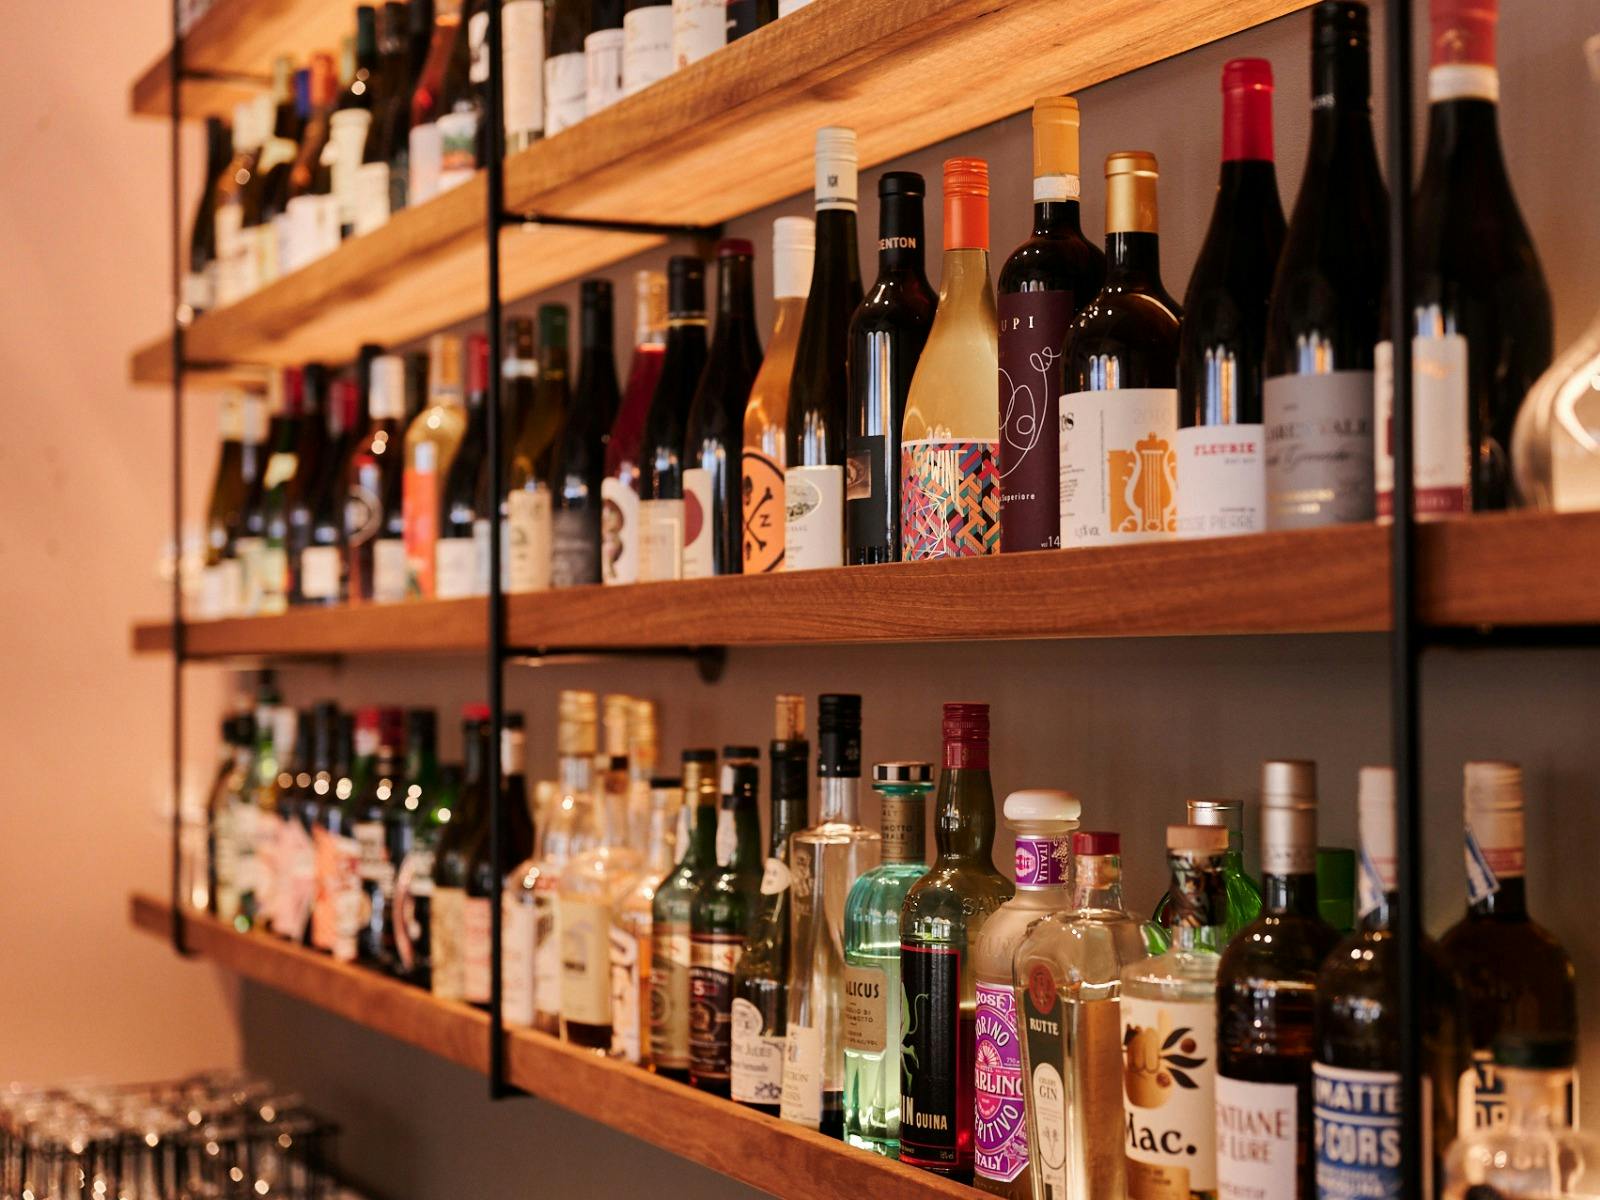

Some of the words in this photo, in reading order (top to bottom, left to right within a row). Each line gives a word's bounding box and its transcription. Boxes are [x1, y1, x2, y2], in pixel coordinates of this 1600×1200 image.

[1037, 844, 1048, 882] ITALIA
[1030, 1017, 1059, 1036] RUTTE
[1040, 1085, 1057, 1101] GIN
